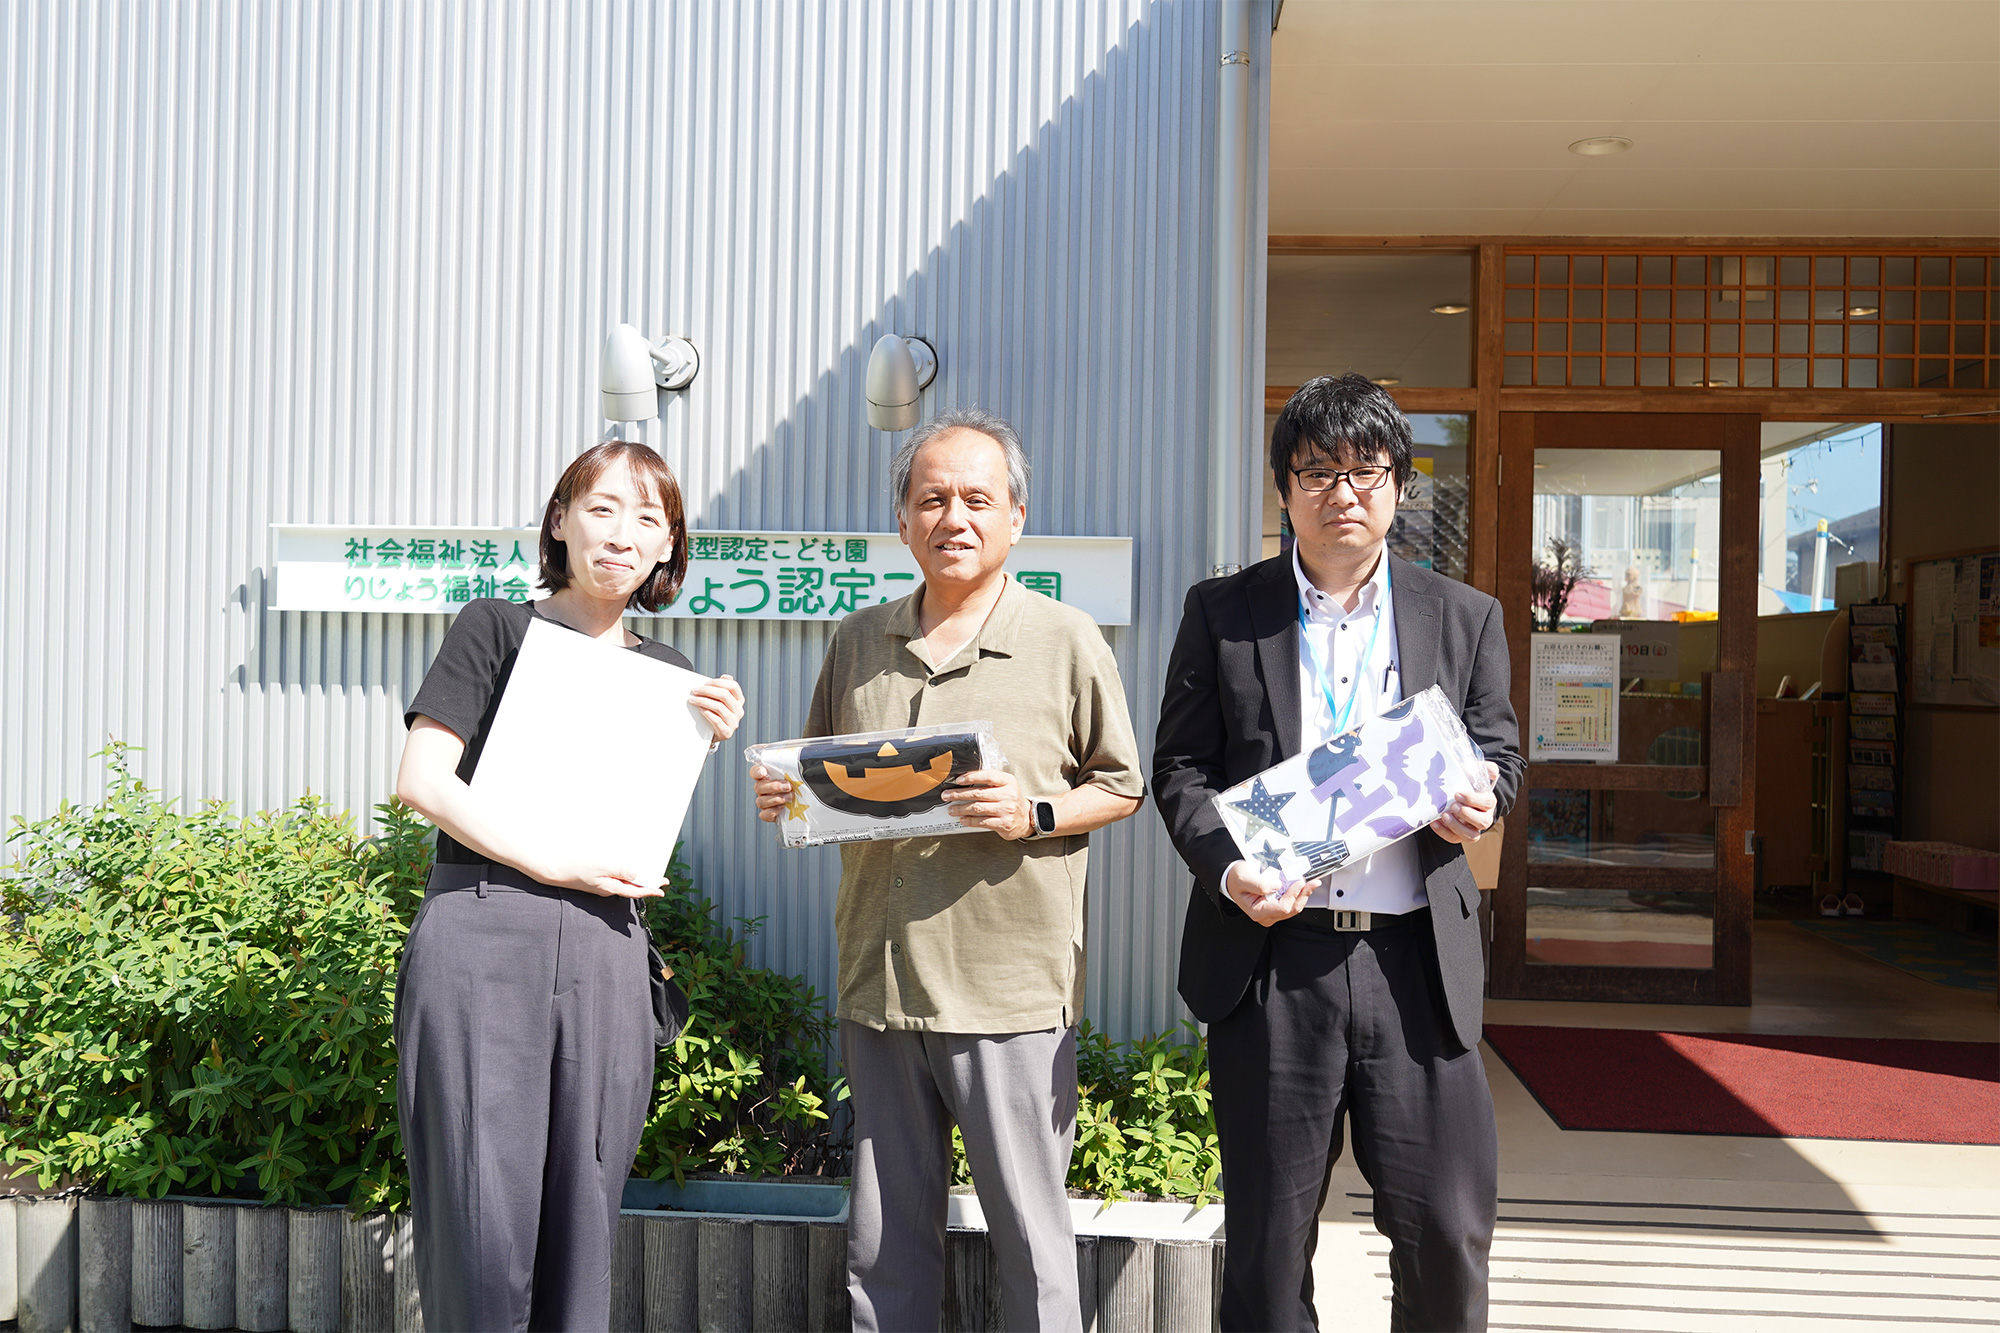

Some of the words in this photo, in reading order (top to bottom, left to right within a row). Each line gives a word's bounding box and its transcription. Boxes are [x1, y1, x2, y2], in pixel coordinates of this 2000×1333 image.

[344, 537, 530, 570] 社会福祉法人
[345, 574, 531, 602] りじょう福祉会
